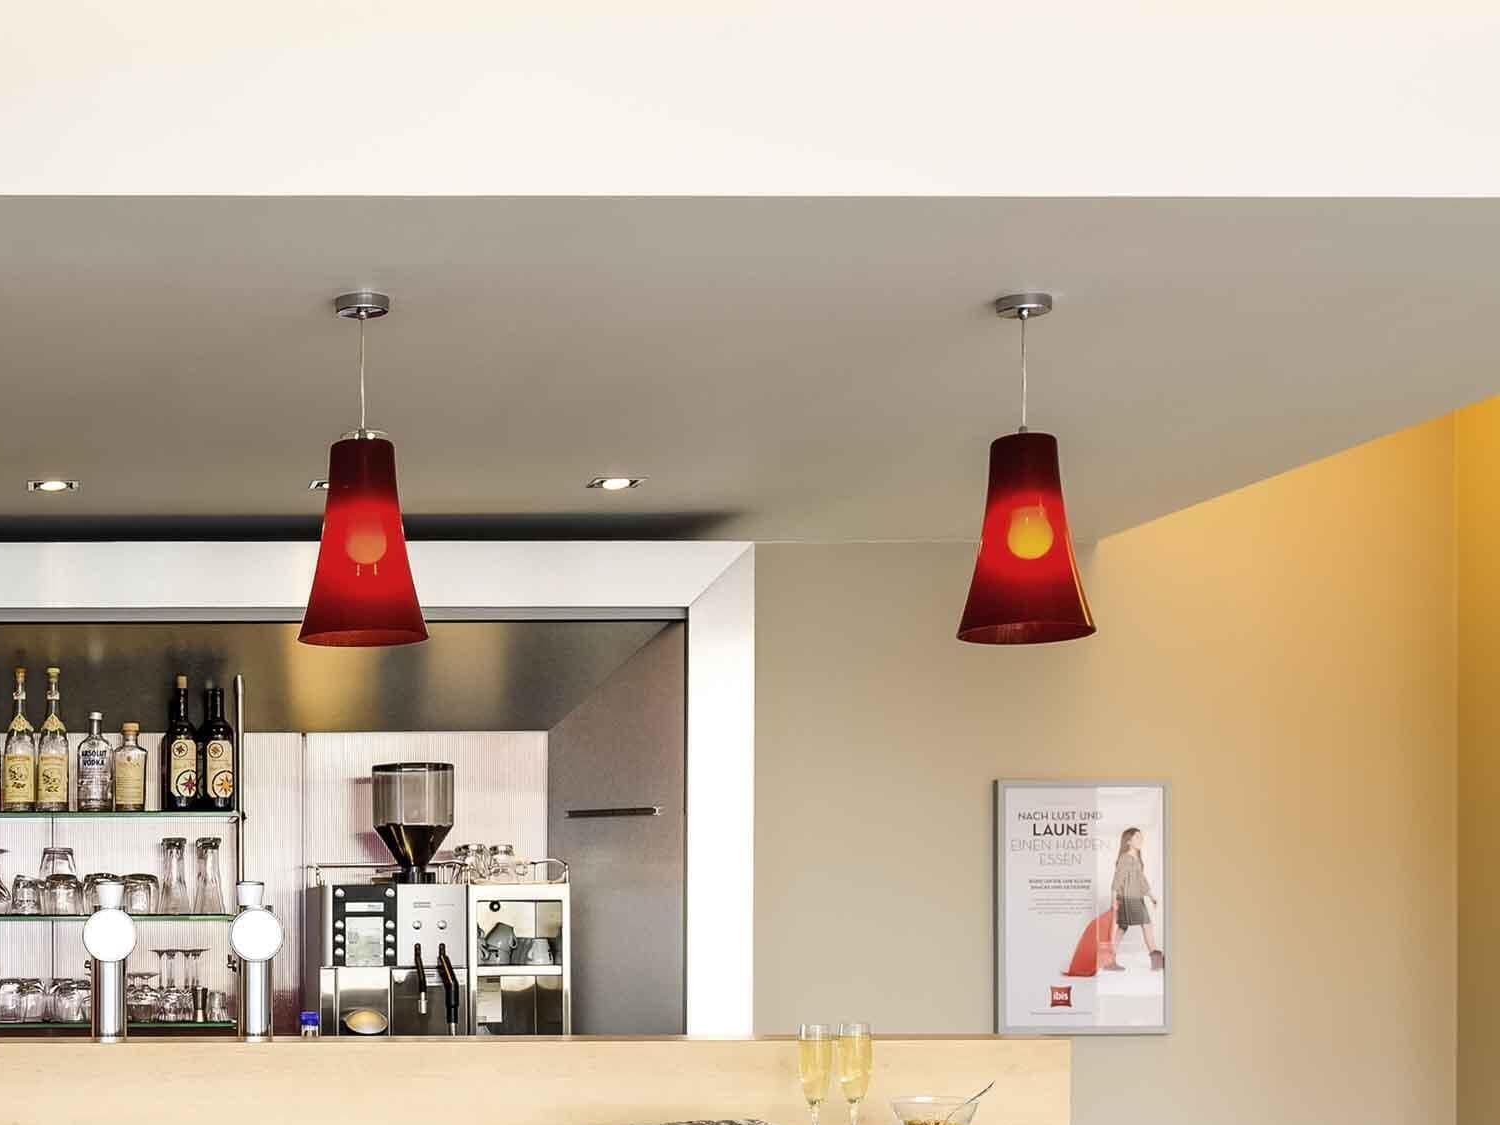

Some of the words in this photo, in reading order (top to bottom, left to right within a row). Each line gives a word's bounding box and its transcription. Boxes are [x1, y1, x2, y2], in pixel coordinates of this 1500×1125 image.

[1018, 811, 1048, 820] NACH
[1052, 811, 1076, 820] LUST
[1080, 811, 1103, 820] UND
[1033, 823, 1088, 836] LAUNE
[1011, 839, 1051, 850] EINEN
[1056, 839, 1108, 850] HAPPEN
[1039, 853, 1082, 865] ESSEN
[1053, 992, 1068, 1000] ibis
